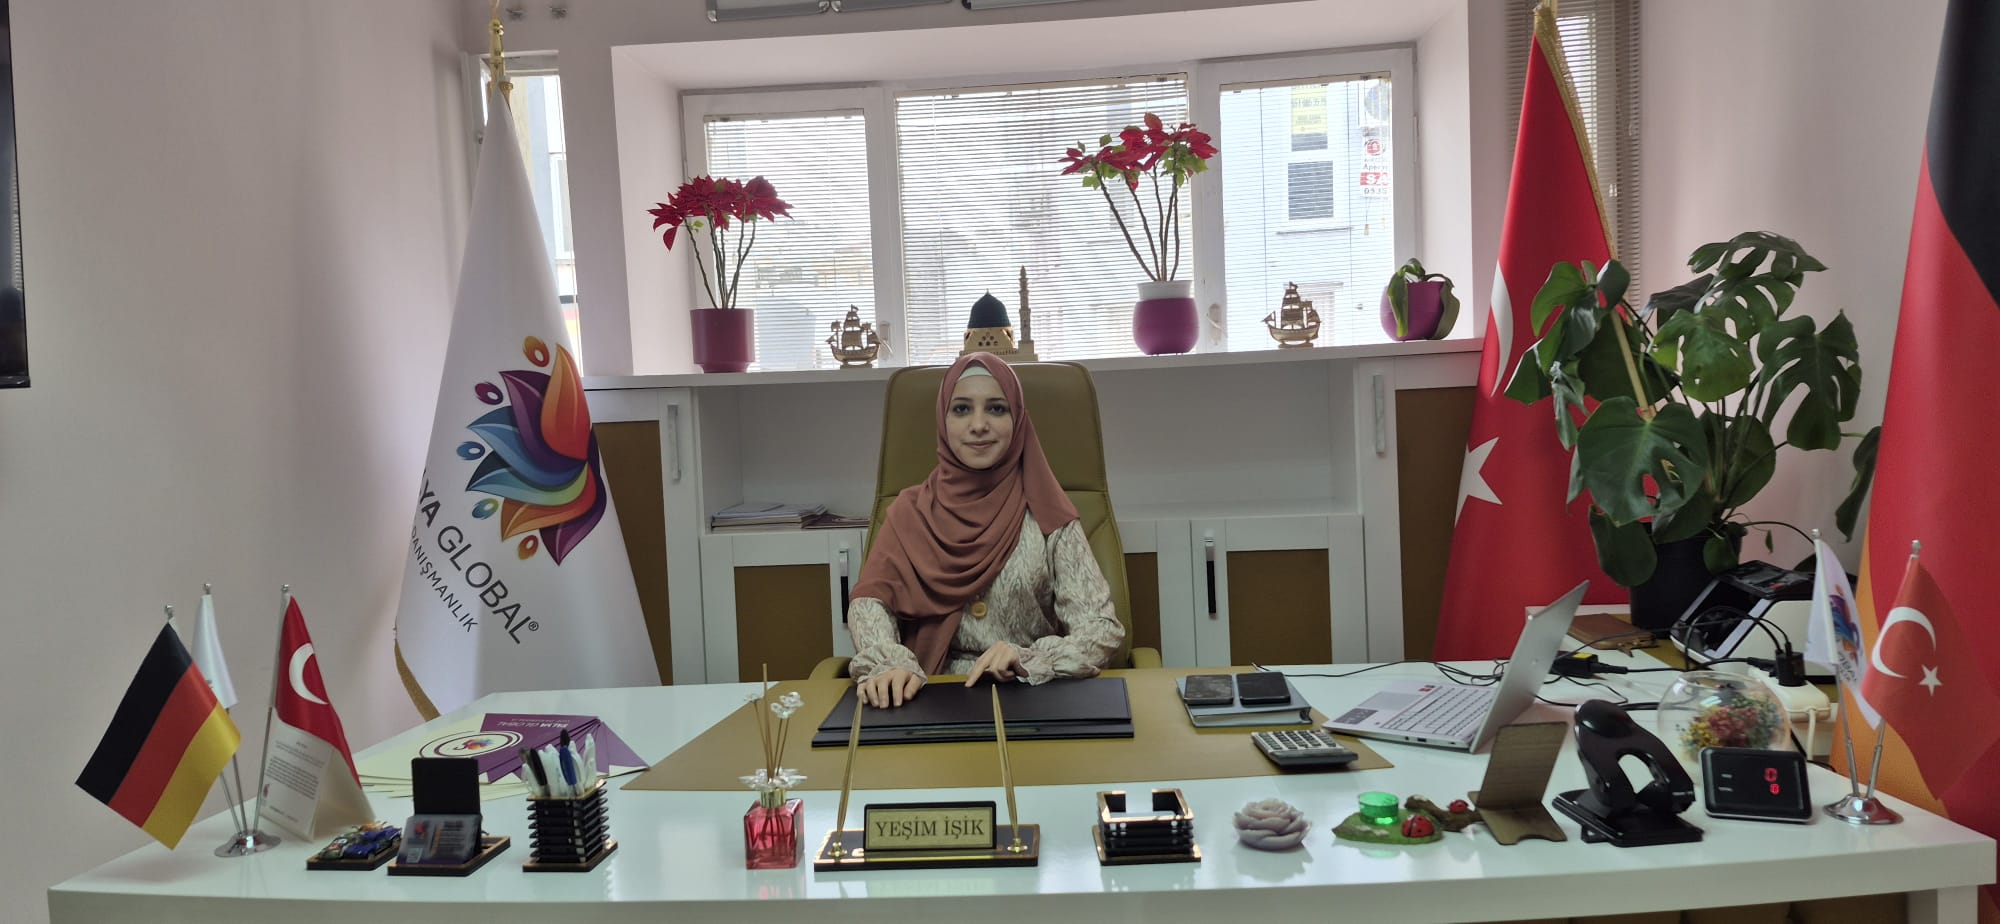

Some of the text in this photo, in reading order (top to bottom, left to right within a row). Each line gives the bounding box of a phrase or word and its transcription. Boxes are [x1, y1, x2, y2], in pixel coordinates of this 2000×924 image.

[419, 468, 441, 528] YA
[875, 815, 985, 840] YEŞİM İŞİK
